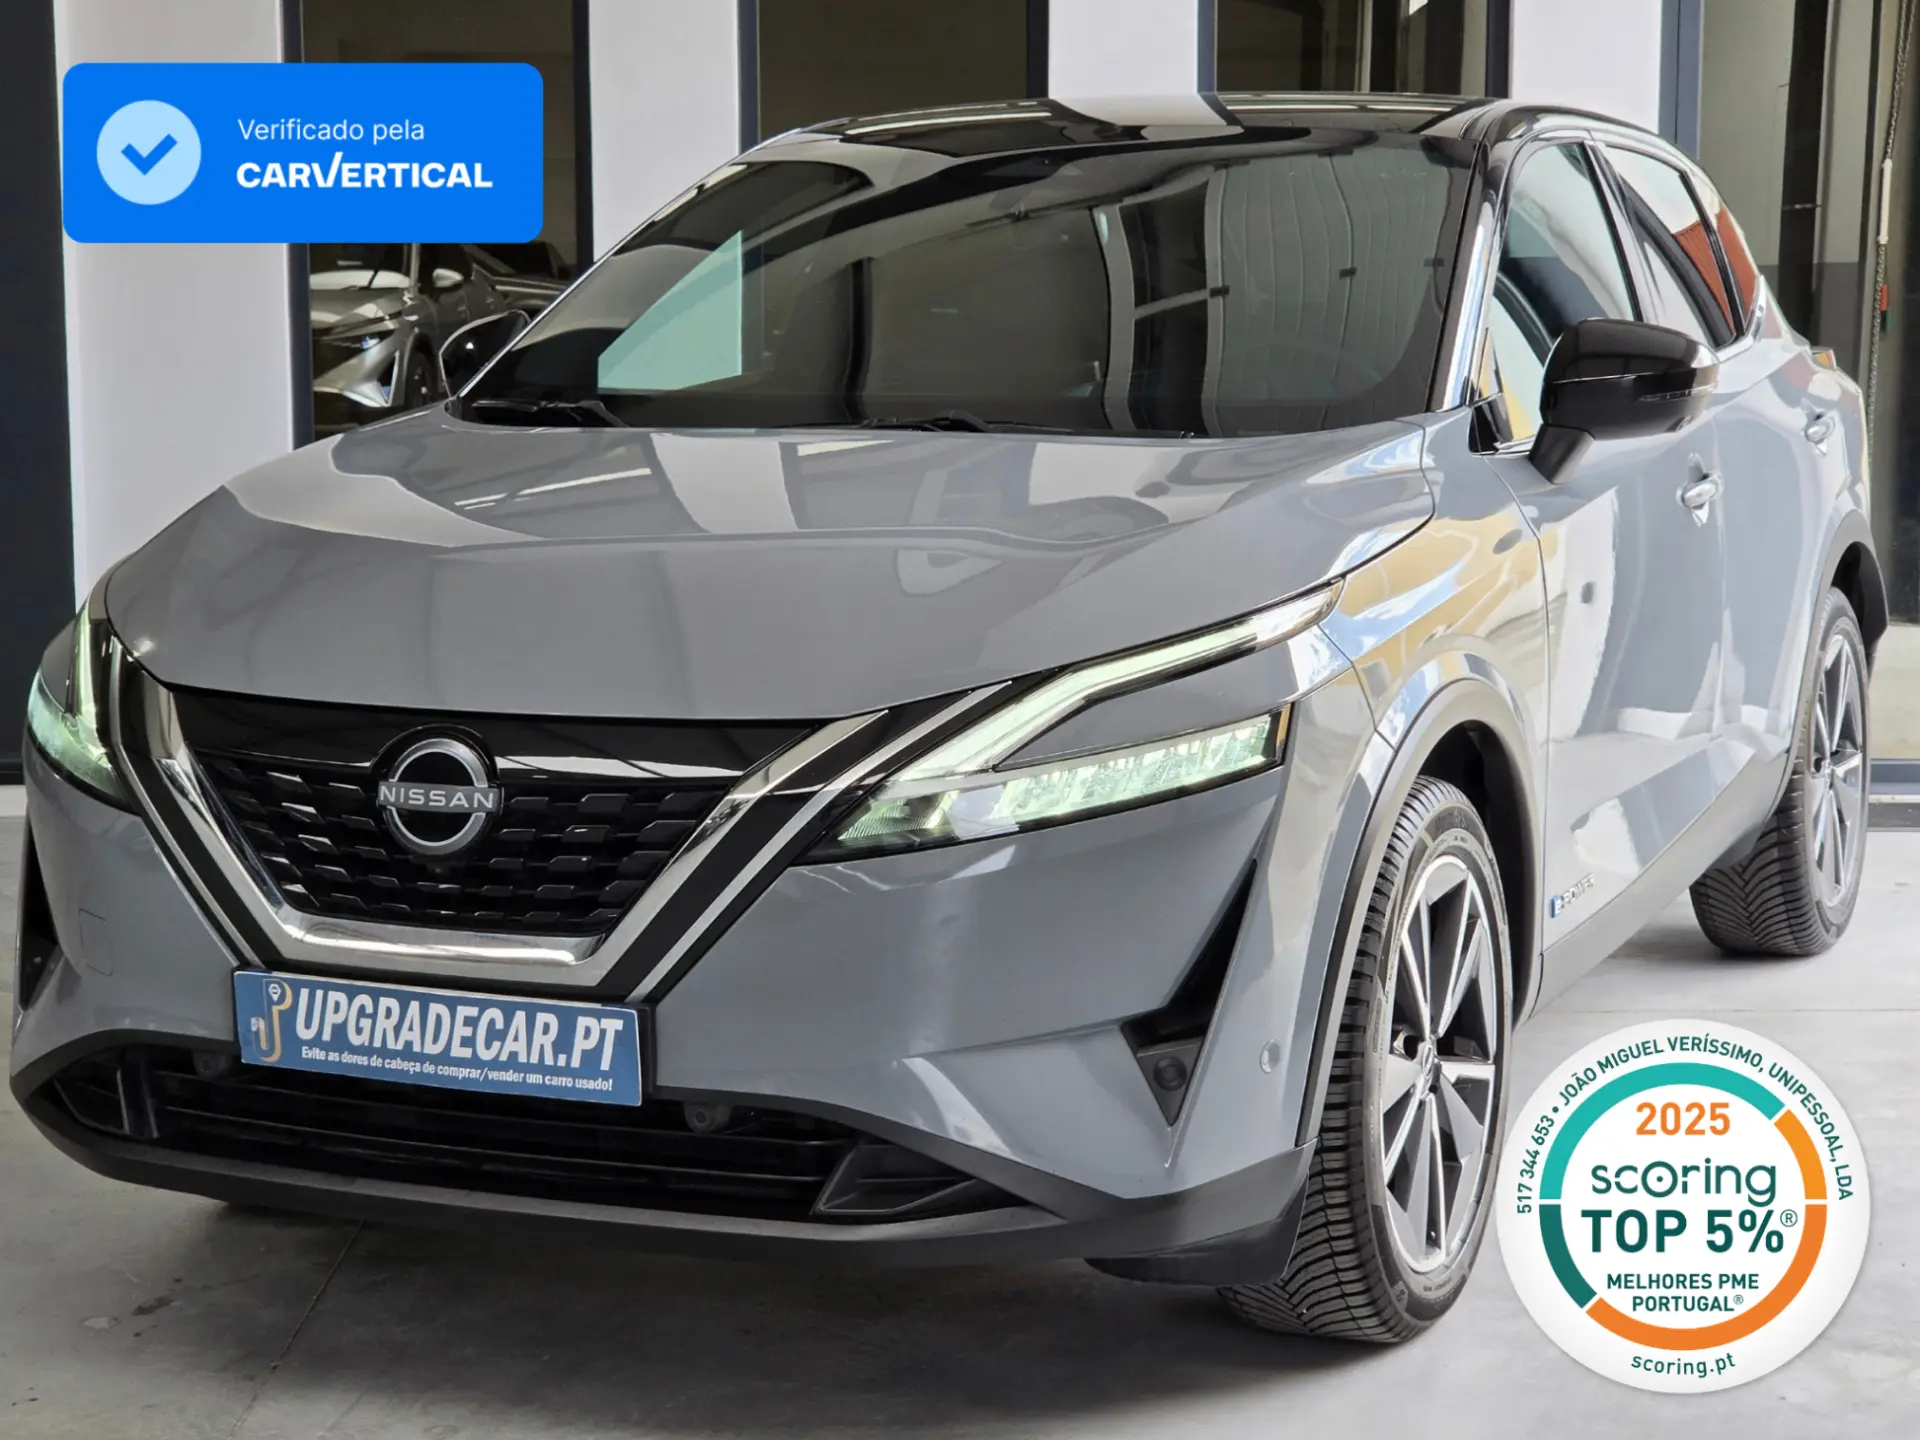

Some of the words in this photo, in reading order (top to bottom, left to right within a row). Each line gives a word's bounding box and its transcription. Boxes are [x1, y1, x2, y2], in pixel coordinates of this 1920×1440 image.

[379, 785, 493, 809] NISSAN
[296, 987, 623, 1071] UPGRADECAR.PT
[302, 1046, 325, 1060] Evite
[327, 1051, 340, 1061] as
[341, 1051, 368, 1066] dores
[370, 1055, 383, 1068] de
[384, 1056, 421, 1074] cabeça
[423, 1060, 436, 1073] de
[437, 1063, 524, 1083] comprar/vender
[526, 1072, 542, 1084] um
[545, 1075, 573, 1087] carro
[575, 1077, 612, 1091] usado!
